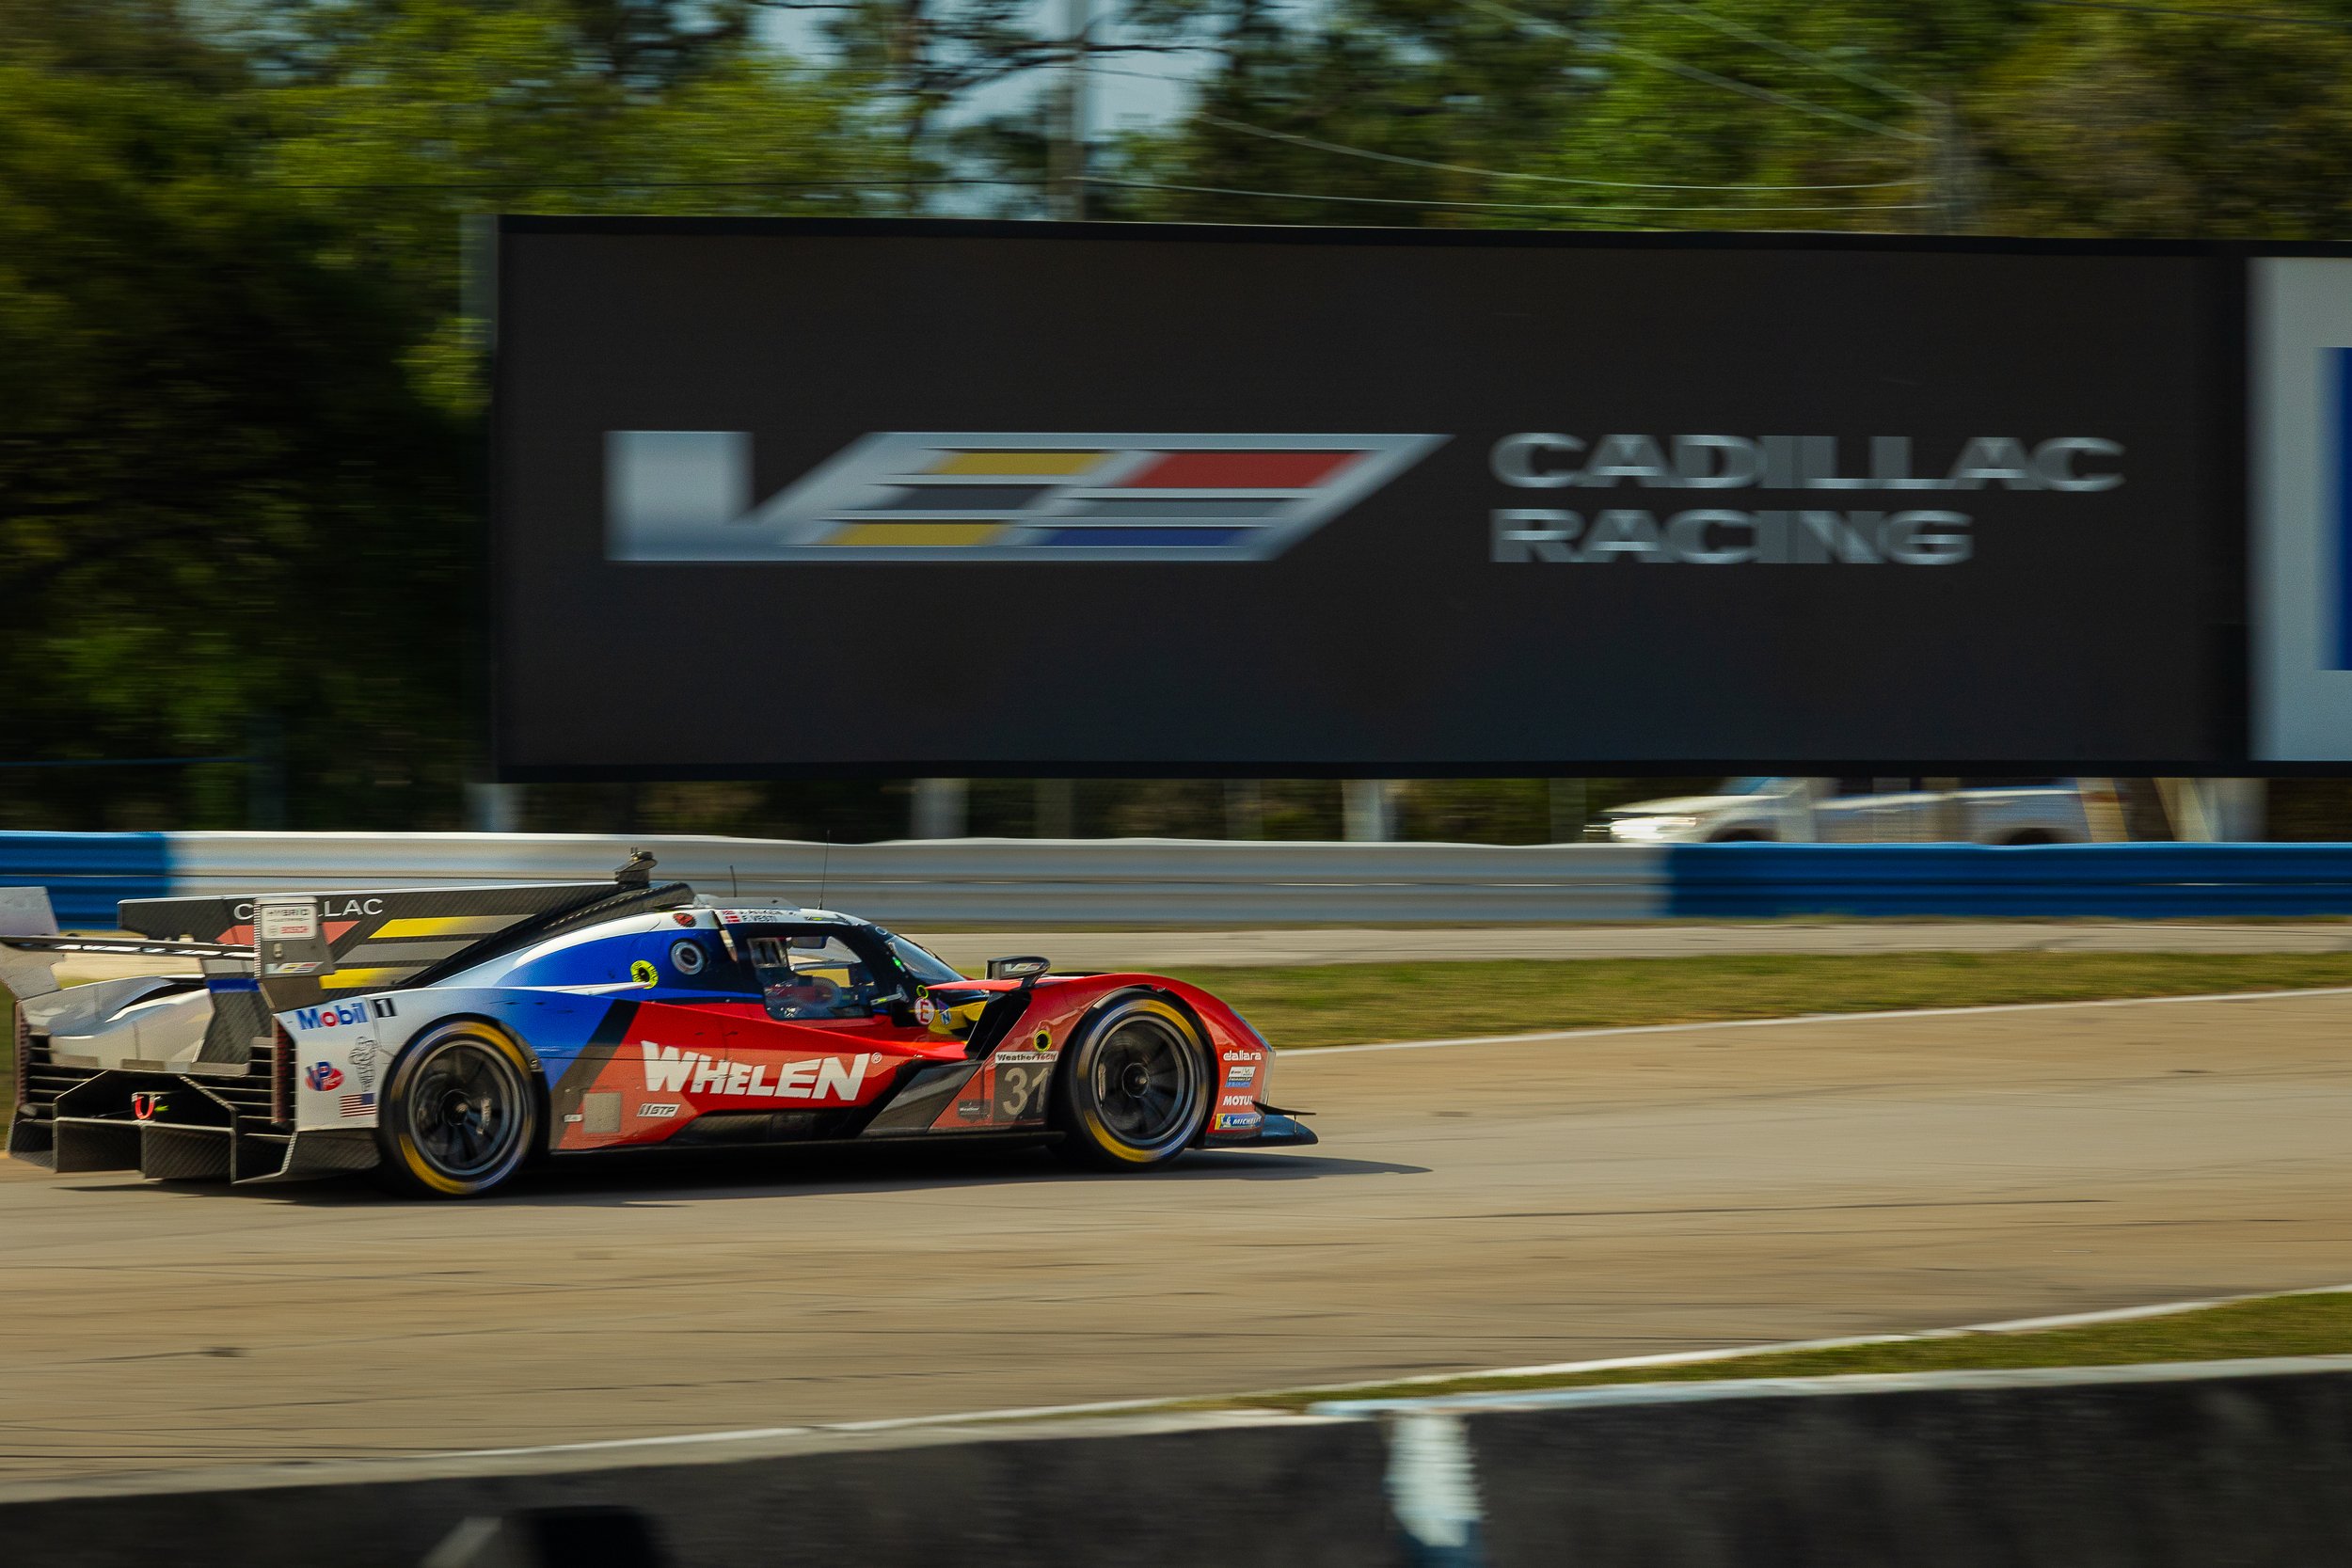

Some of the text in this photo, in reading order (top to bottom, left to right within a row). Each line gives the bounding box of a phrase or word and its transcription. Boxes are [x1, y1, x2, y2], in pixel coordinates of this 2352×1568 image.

[1491, 433, 2124, 491] CADILLAC
[1490, 509, 1974, 563] RACING
[233, 898, 384, 921] CLAC
[295, 1002, 369, 1030] Mobil
[920, 1001, 930, 1022] E
[641, 1040, 871, 1101] WHELEN
[1223, 1050, 1262, 1061] dallara
[1003, 1067, 1049, 1115] 31
